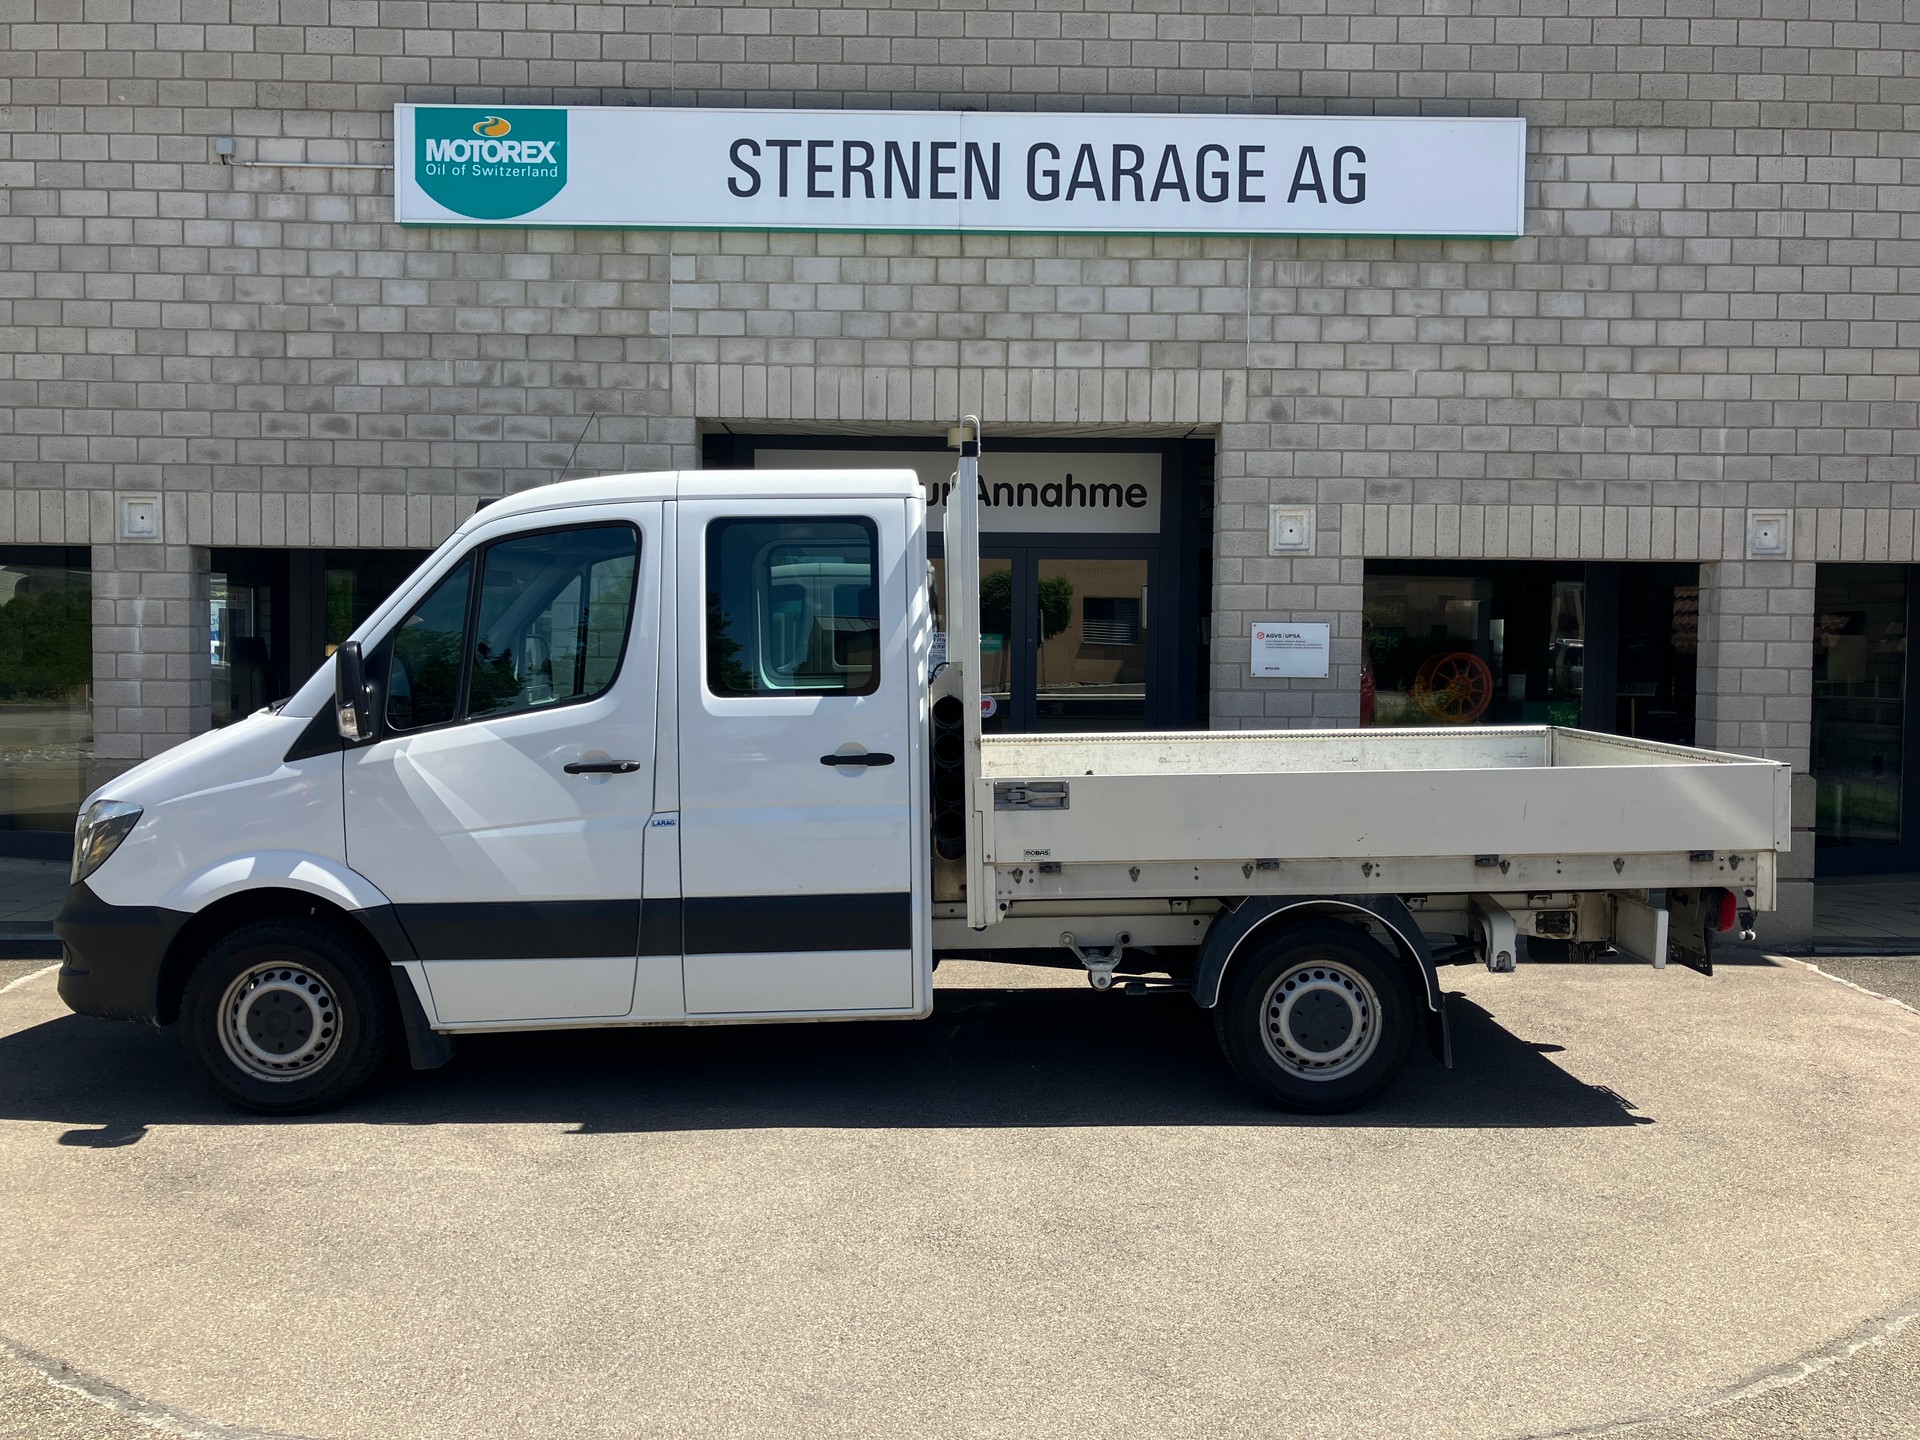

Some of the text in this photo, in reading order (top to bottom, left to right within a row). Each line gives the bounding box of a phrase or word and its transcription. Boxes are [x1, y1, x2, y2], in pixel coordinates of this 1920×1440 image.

[425, 138, 557, 164] MOTOREX
[425, 163, 558, 178] Oil of Switzerland
[727, 138, 1367, 204] STERNEN GARAGE AG
[977, 473, 1148, 509] Annahme
